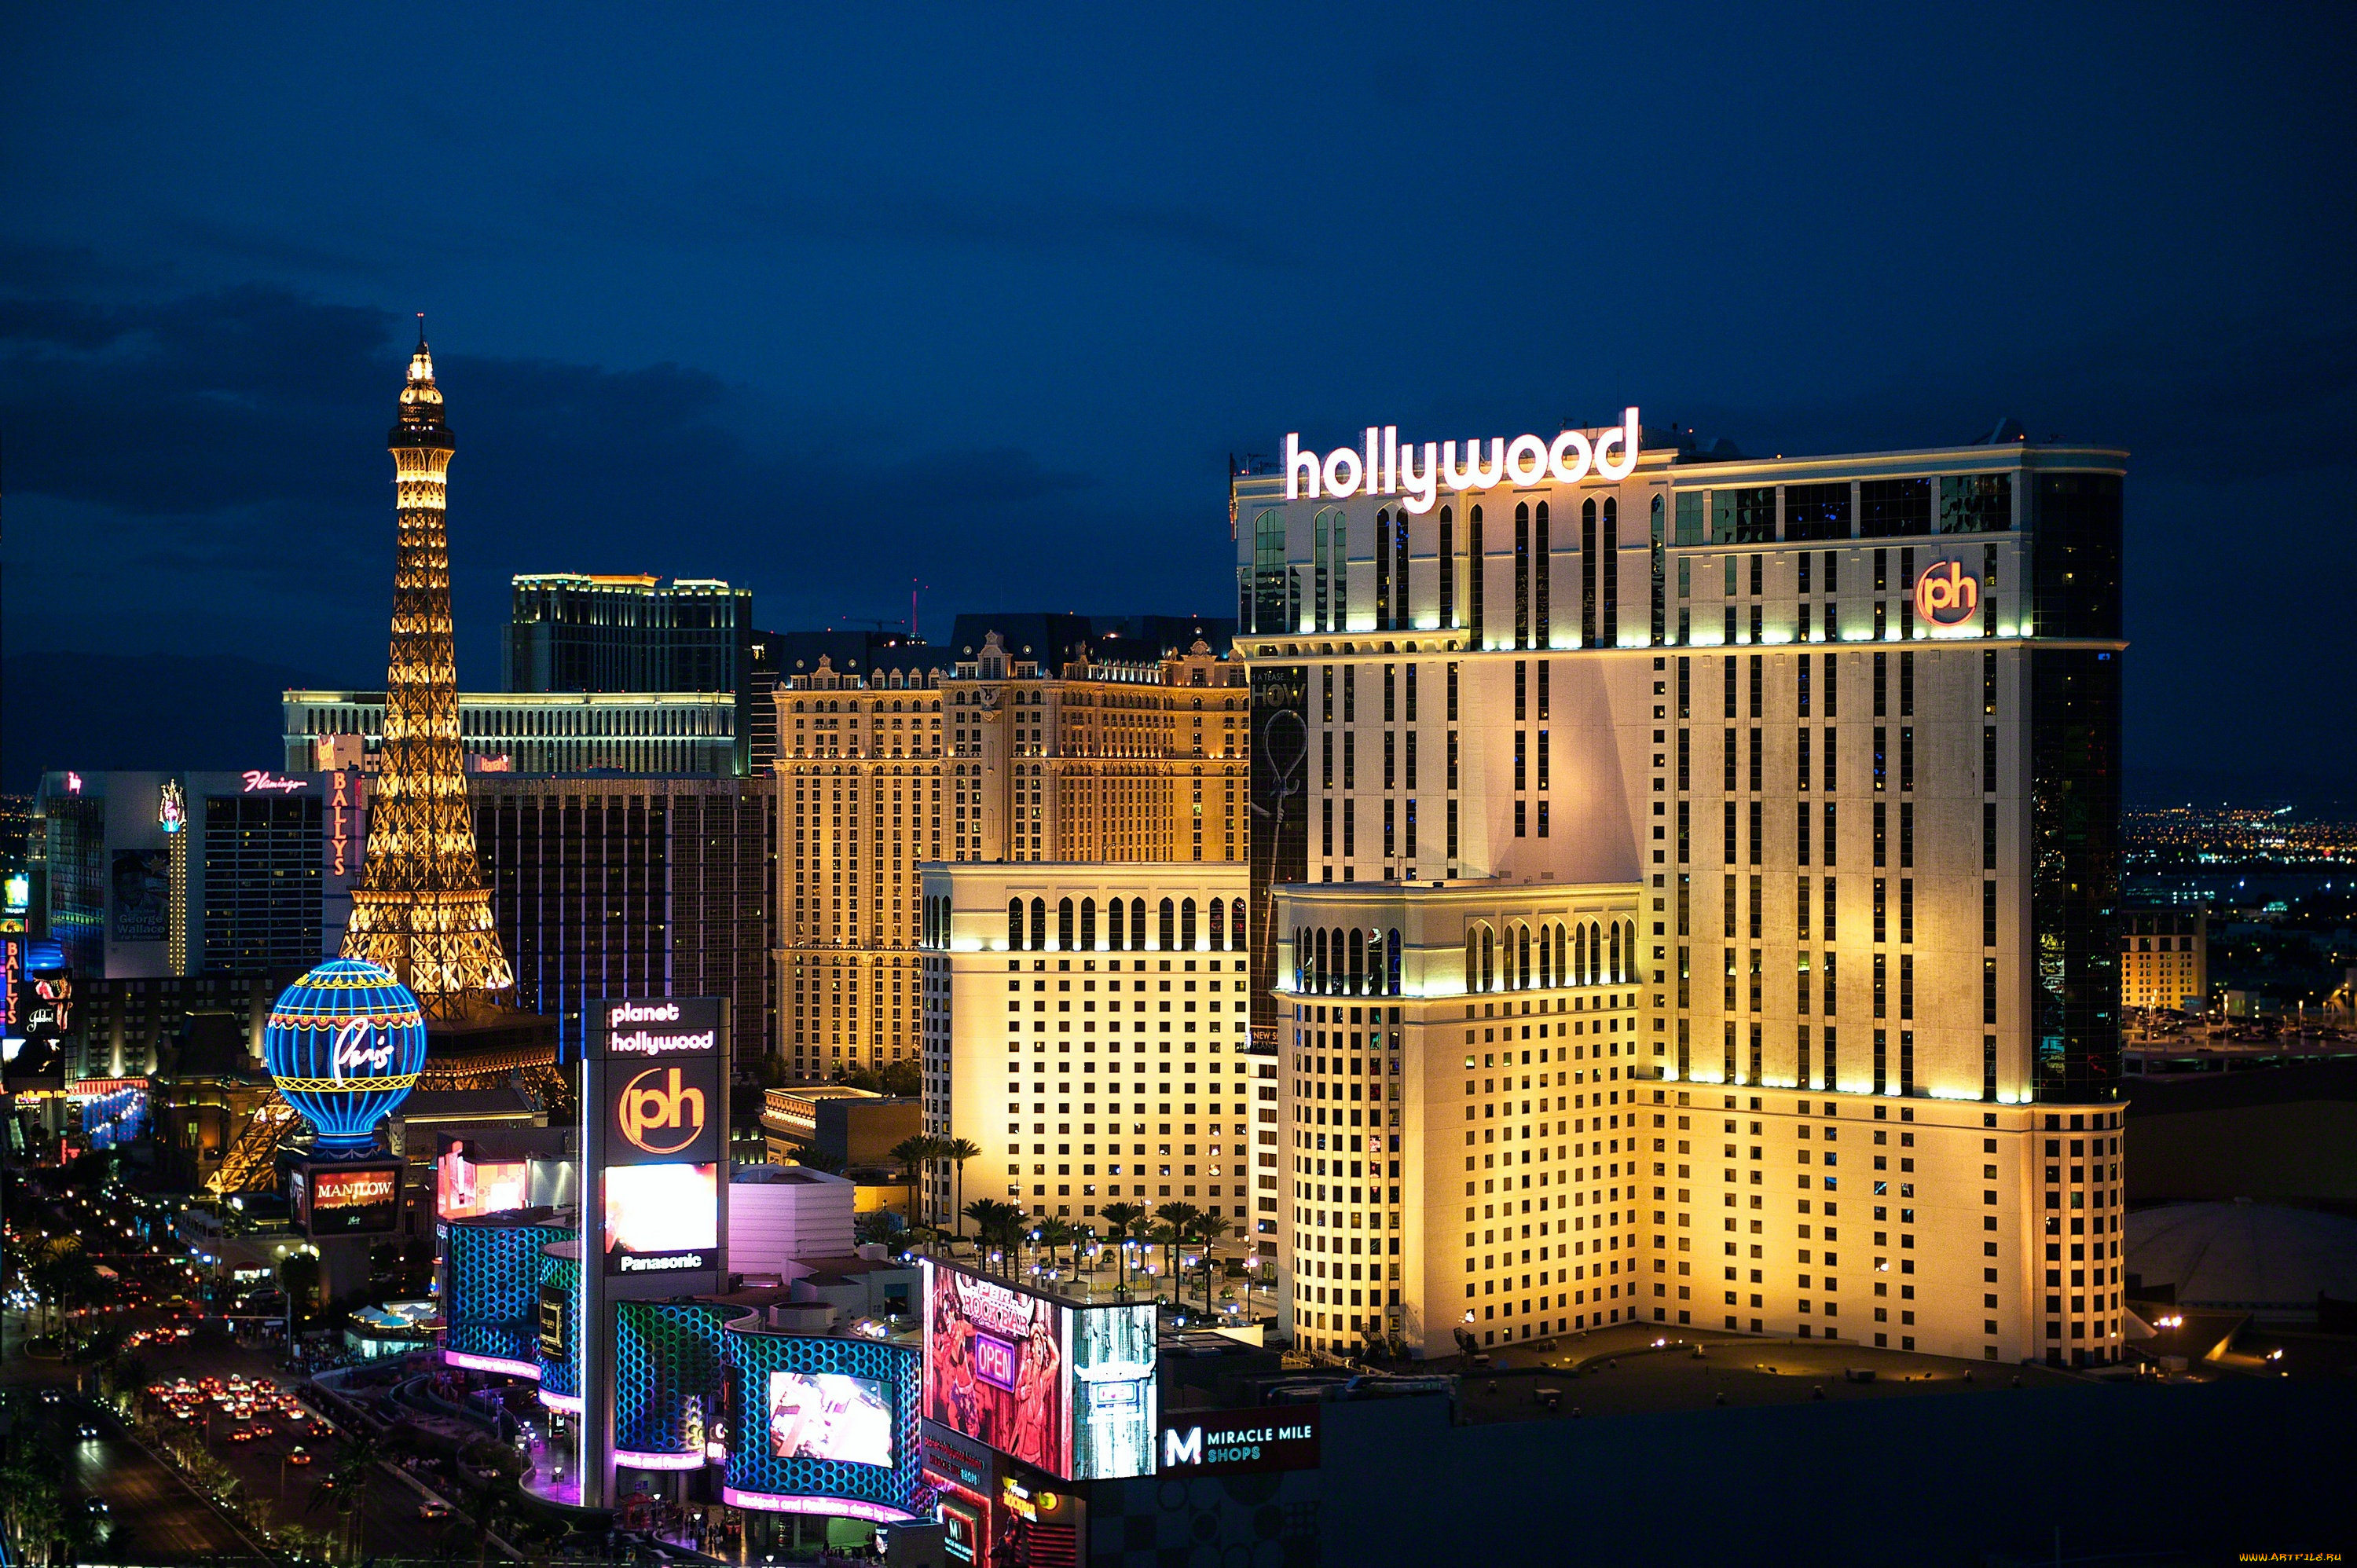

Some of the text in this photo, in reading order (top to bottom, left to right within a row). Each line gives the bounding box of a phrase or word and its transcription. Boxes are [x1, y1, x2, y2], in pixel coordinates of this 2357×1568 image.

[1286, 407, 1639, 514] hollywood
[1923, 561, 1978, 617] ph
[242, 770, 307, 793] Flamingo
[117, 925, 165, 933] Wallace
[119, 914, 163, 925] George
[611, 1002, 680, 1028] planet
[611, 1031, 714, 1056] hollywood
[1253, 1031, 1270, 1039] NEW
[333, 1017, 394, 1088] Paris
[629, 1067, 706, 1141] ph
[621, 1252, 702, 1271] Panasonic
[979, 1284, 1014, 1304] PBR
[978, 1343, 1011, 1381] OPEN
[1168, 1427, 1201, 1467] M
[1208, 1425, 1311, 1445] MIRACLE MILE
[1208, 1446, 1260, 1463] SHOPS
